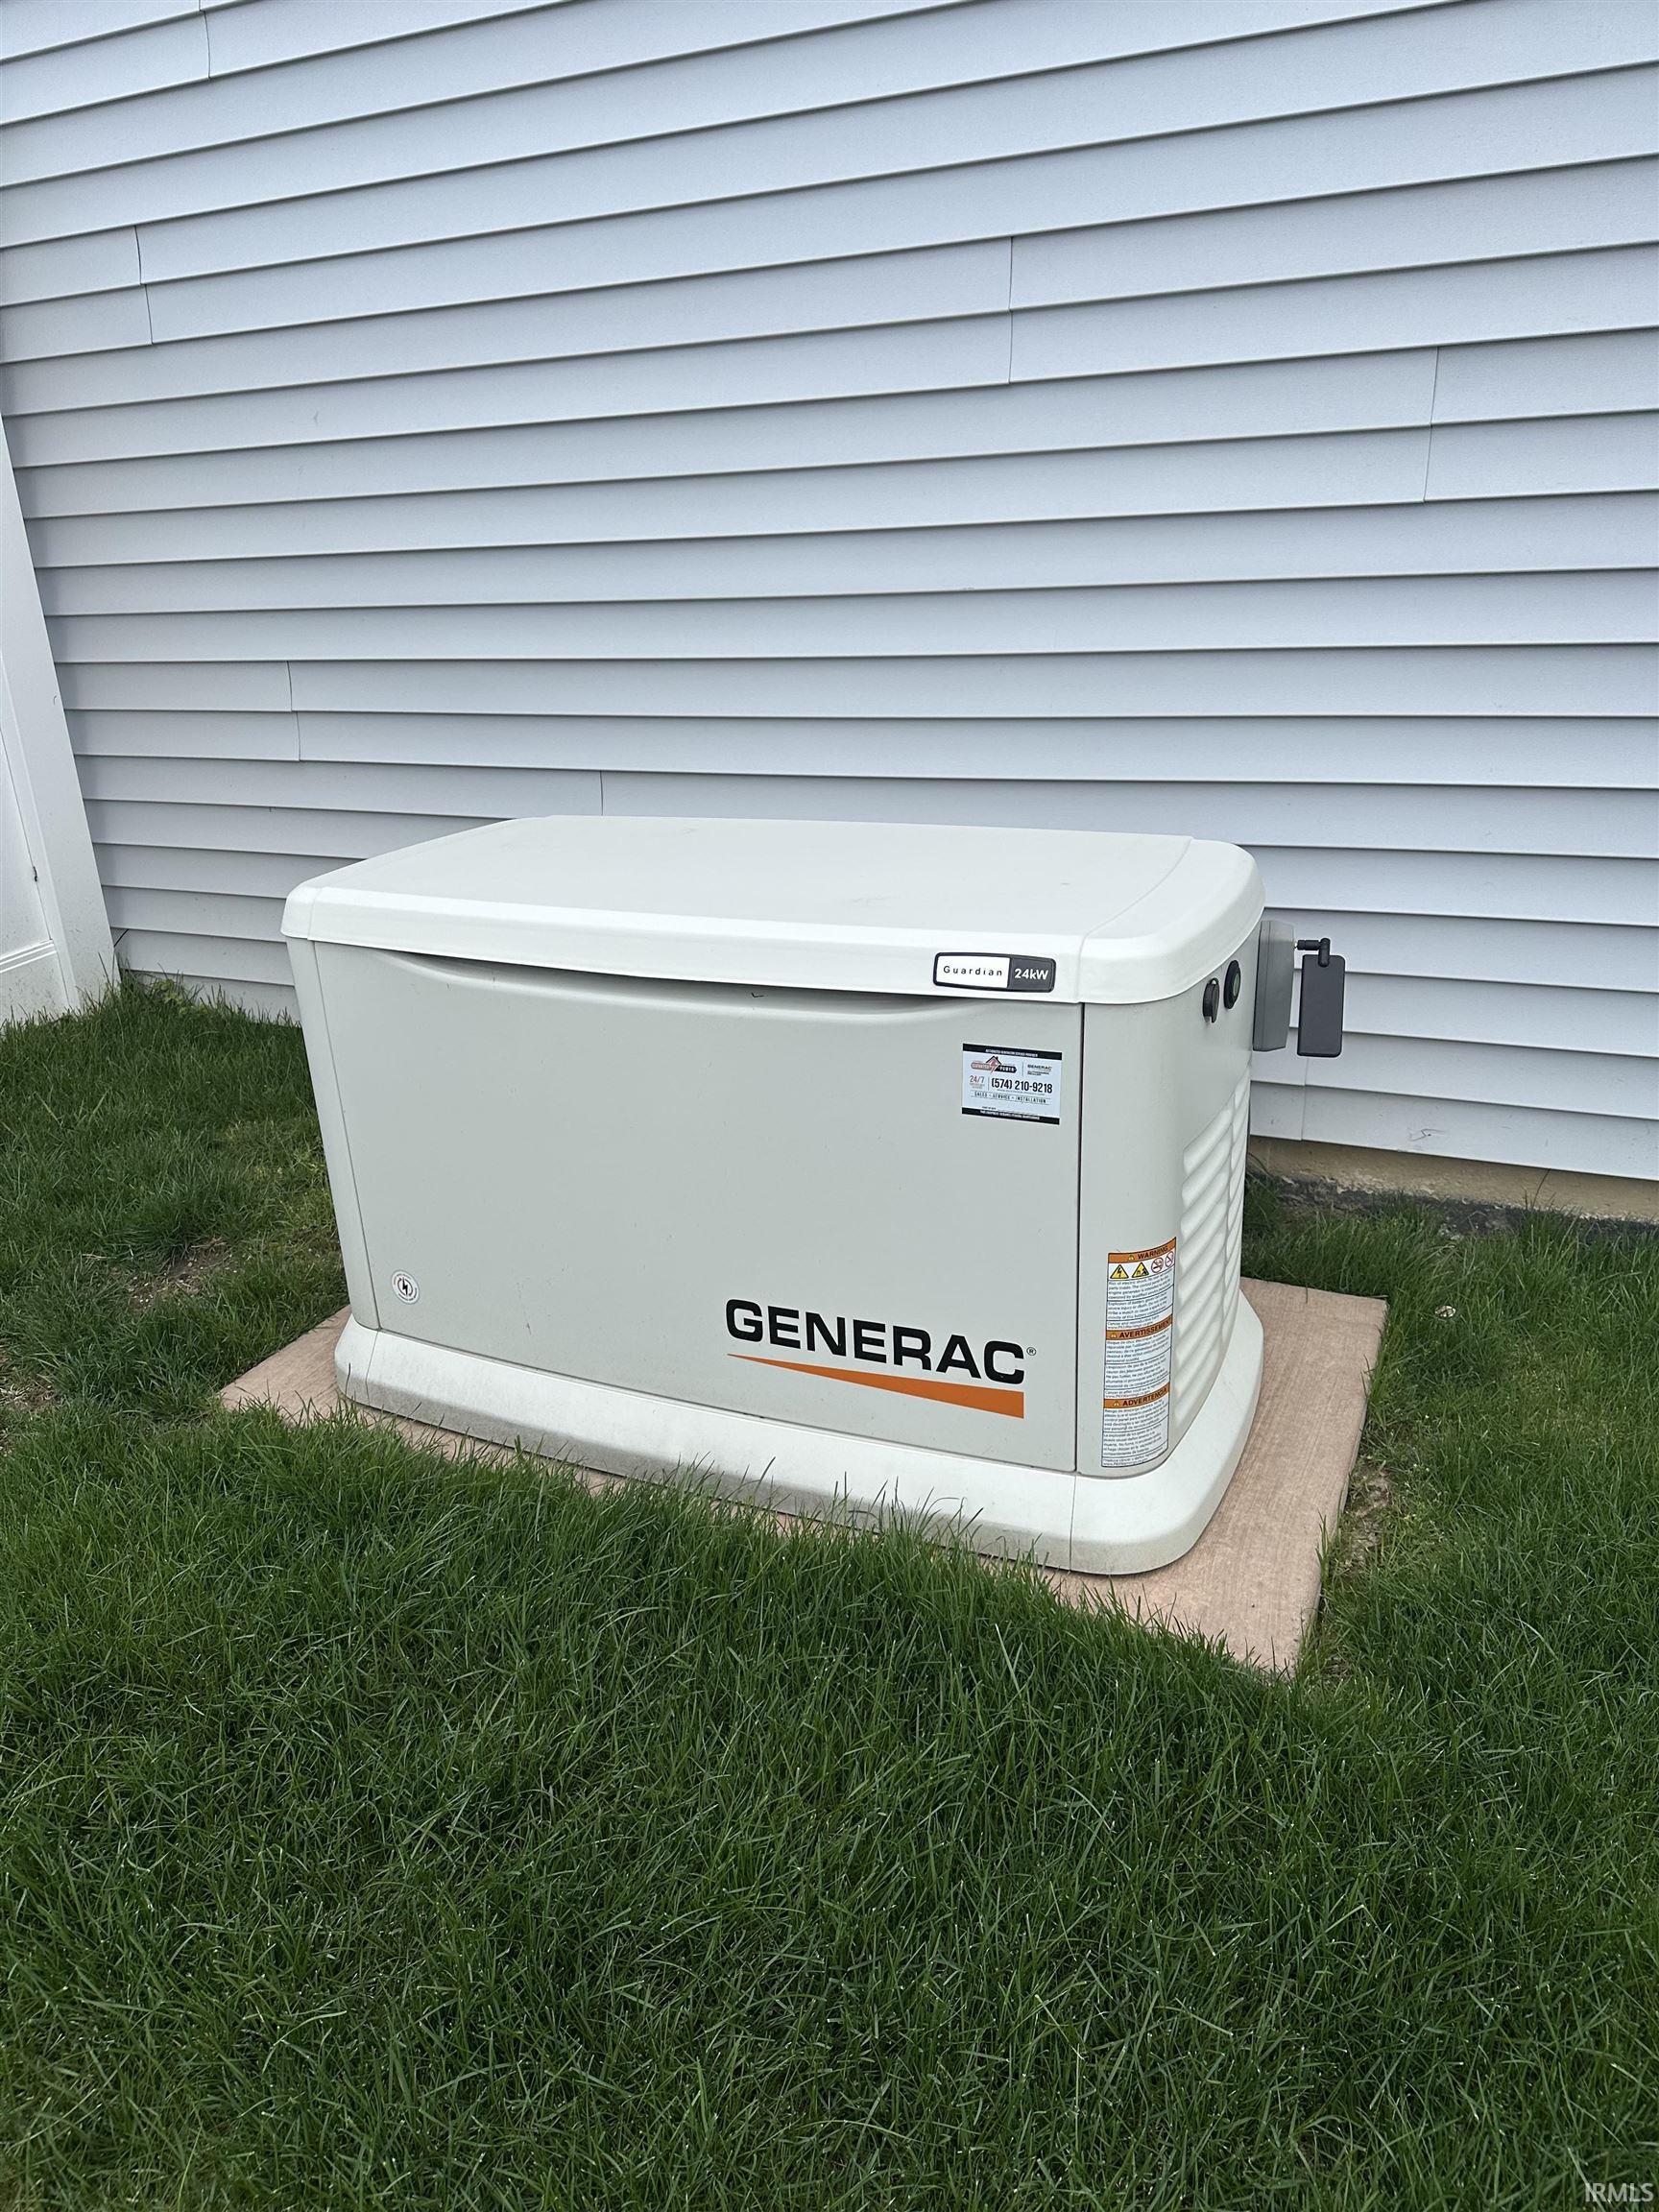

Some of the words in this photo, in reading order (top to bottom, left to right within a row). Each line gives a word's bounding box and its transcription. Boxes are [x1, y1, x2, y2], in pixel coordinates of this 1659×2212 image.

[943, 965, 1002, 976] Guardian
[1014, 968, 1049, 980] 24kW
[970, 1075, 985, 1084] 24/7
[991, 1077, 1013, 1090] (574)
[1015, 1080, 1053, 1094] 210-9218
[1137, 1246, 1168, 1260] WARNING
[726, 1298, 1025, 1385] GENERAC
